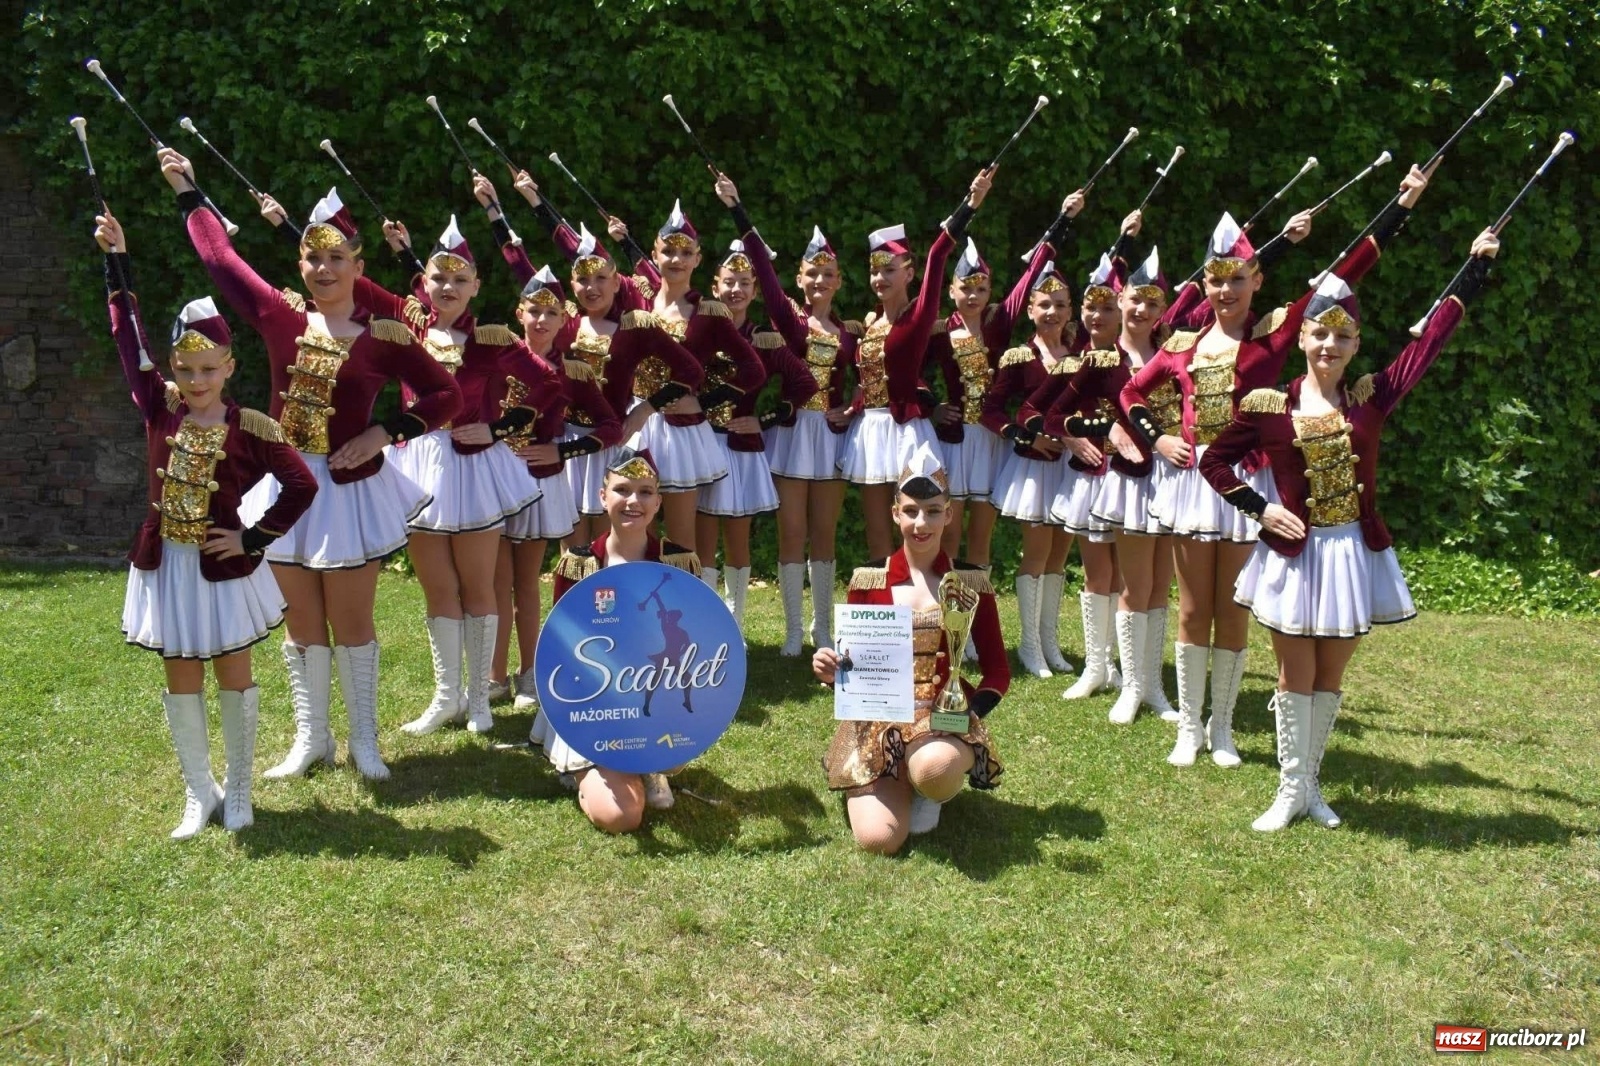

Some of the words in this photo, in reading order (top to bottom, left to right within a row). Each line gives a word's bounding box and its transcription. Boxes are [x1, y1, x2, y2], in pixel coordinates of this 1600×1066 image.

[851, 610, 896, 620] DYPLOM
[548, 635, 728, 703] Scarlet
[570, 707, 640, 723] MAŻORETKI
